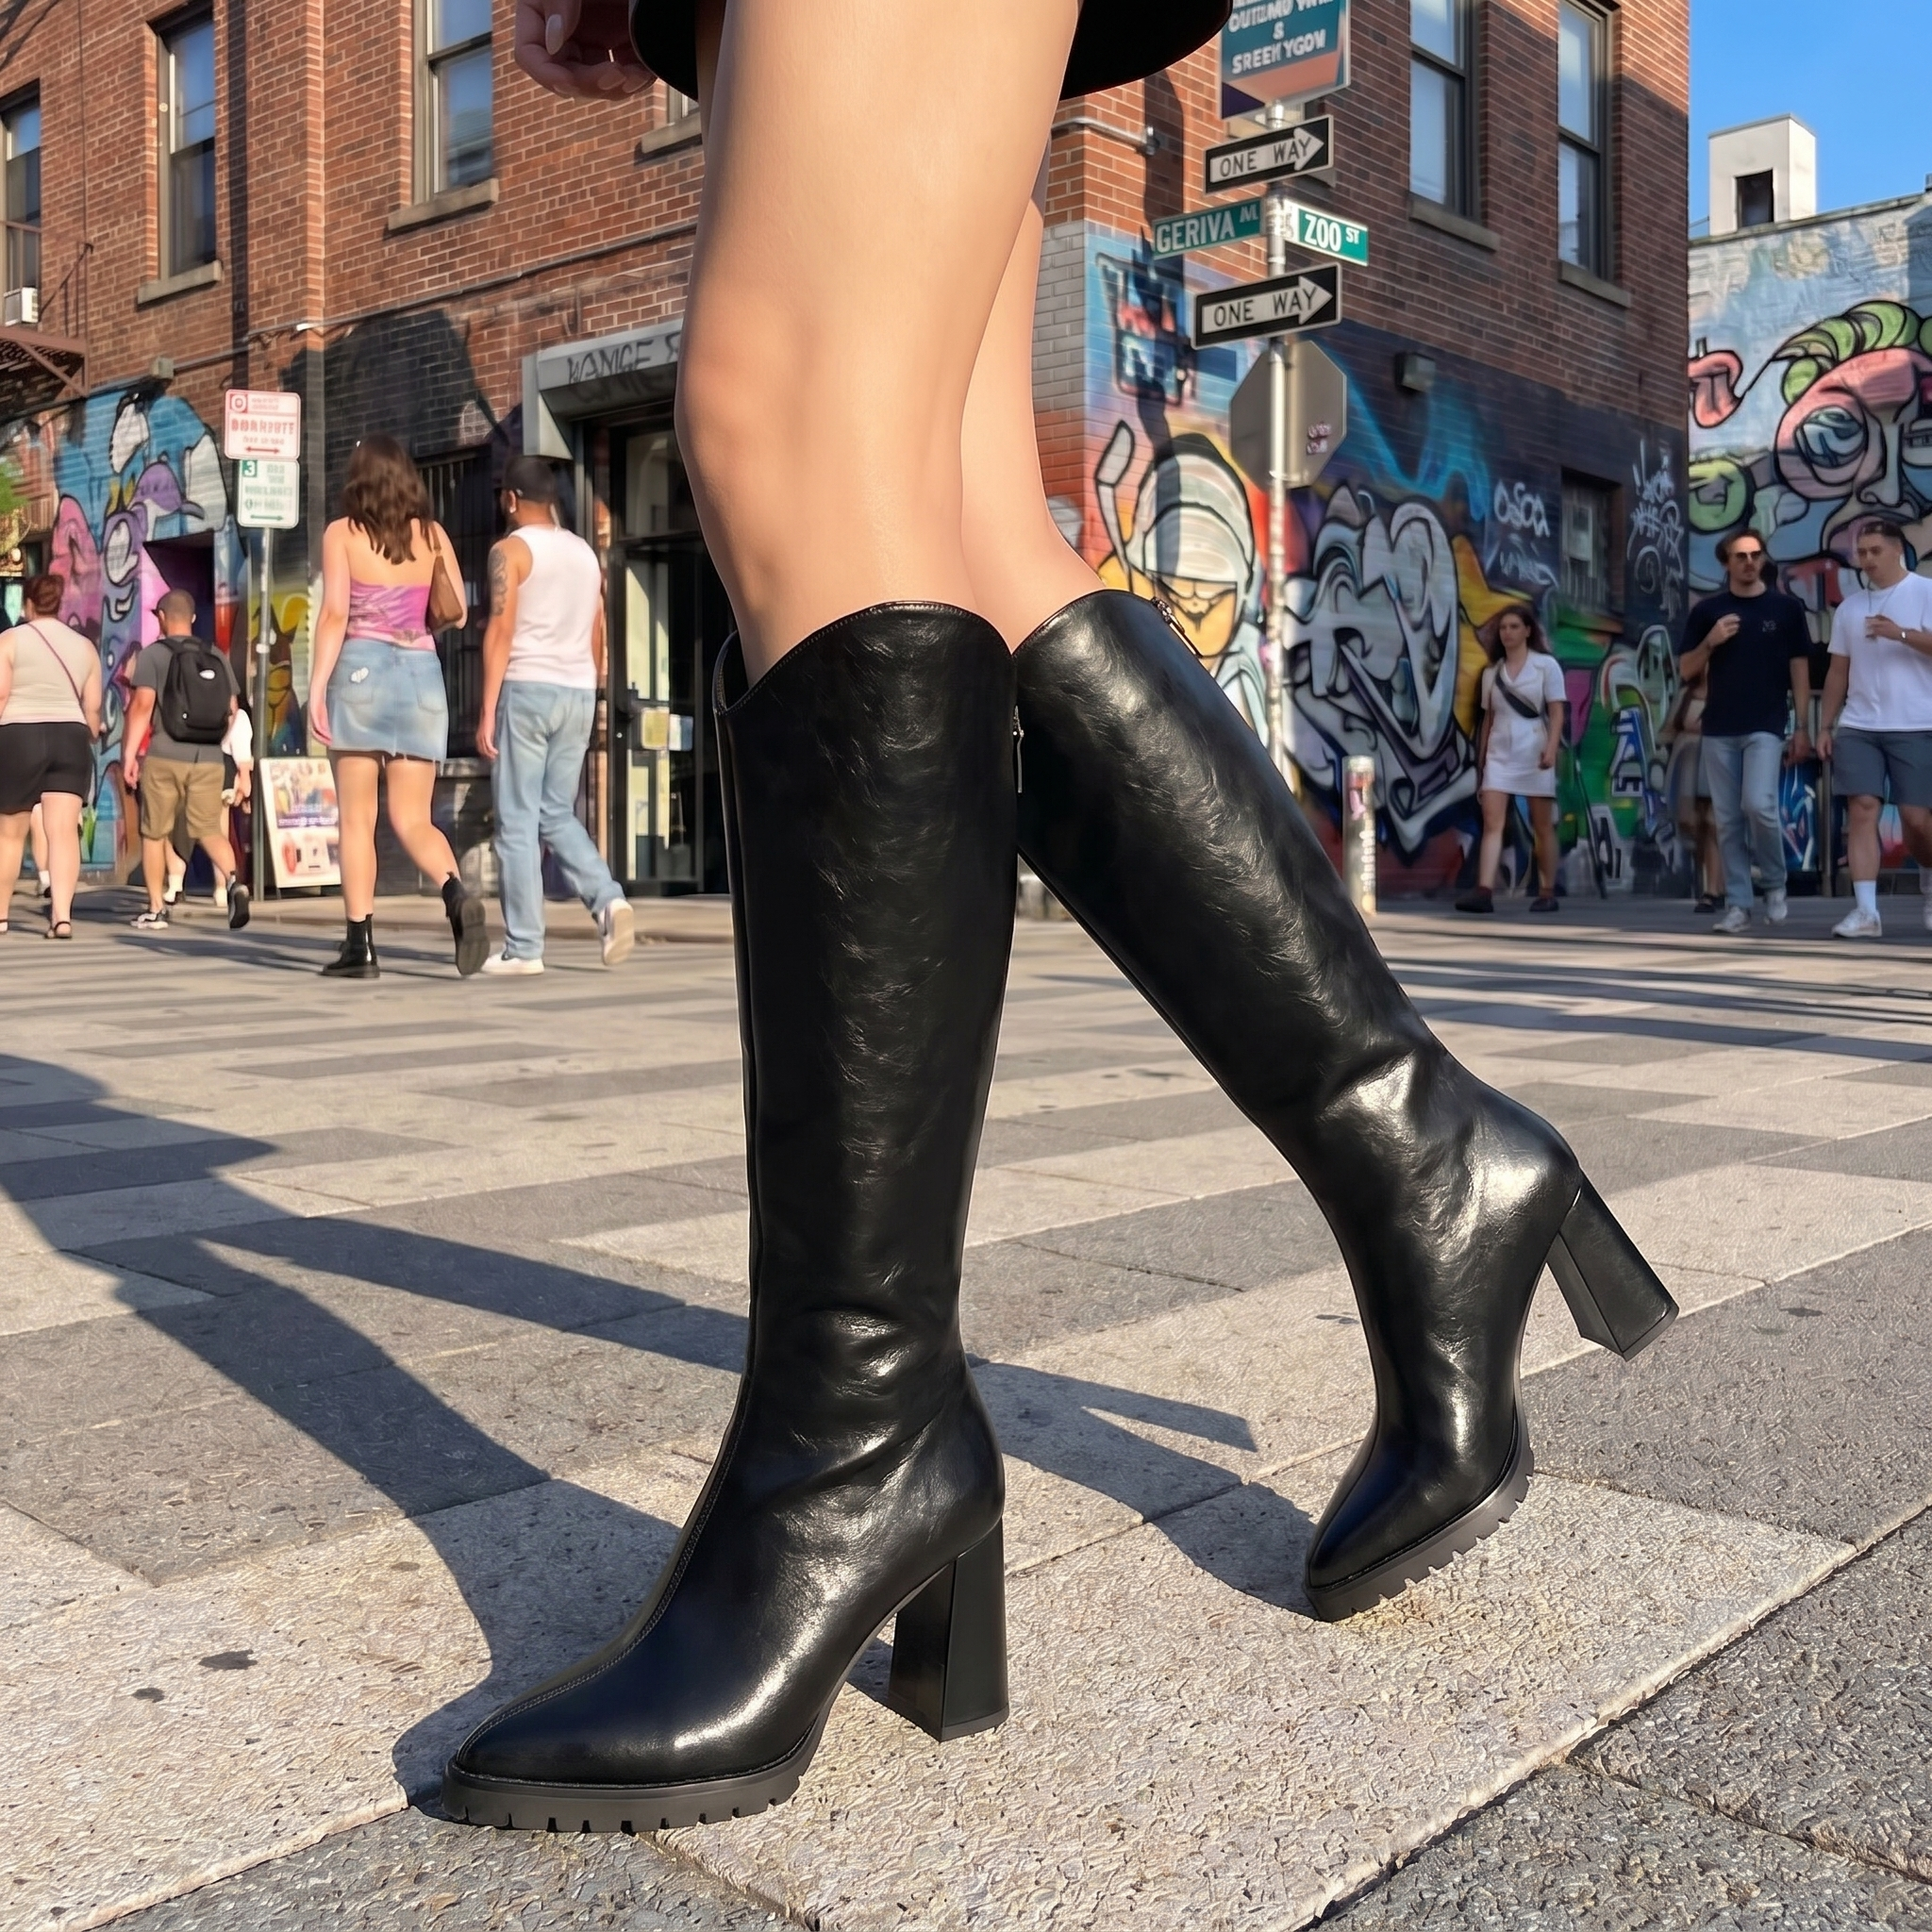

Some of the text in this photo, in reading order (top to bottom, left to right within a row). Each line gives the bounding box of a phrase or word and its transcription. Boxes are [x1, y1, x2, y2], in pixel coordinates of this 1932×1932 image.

[1220, 137, 1311, 177] ONE WAY
[1157, 210, 1236, 255] GERIVA
[1304, 214, 1341, 252] ZOO
[1345, 227, 1359, 244] ST
[1214, 287, 1317, 327] ONE WAY
